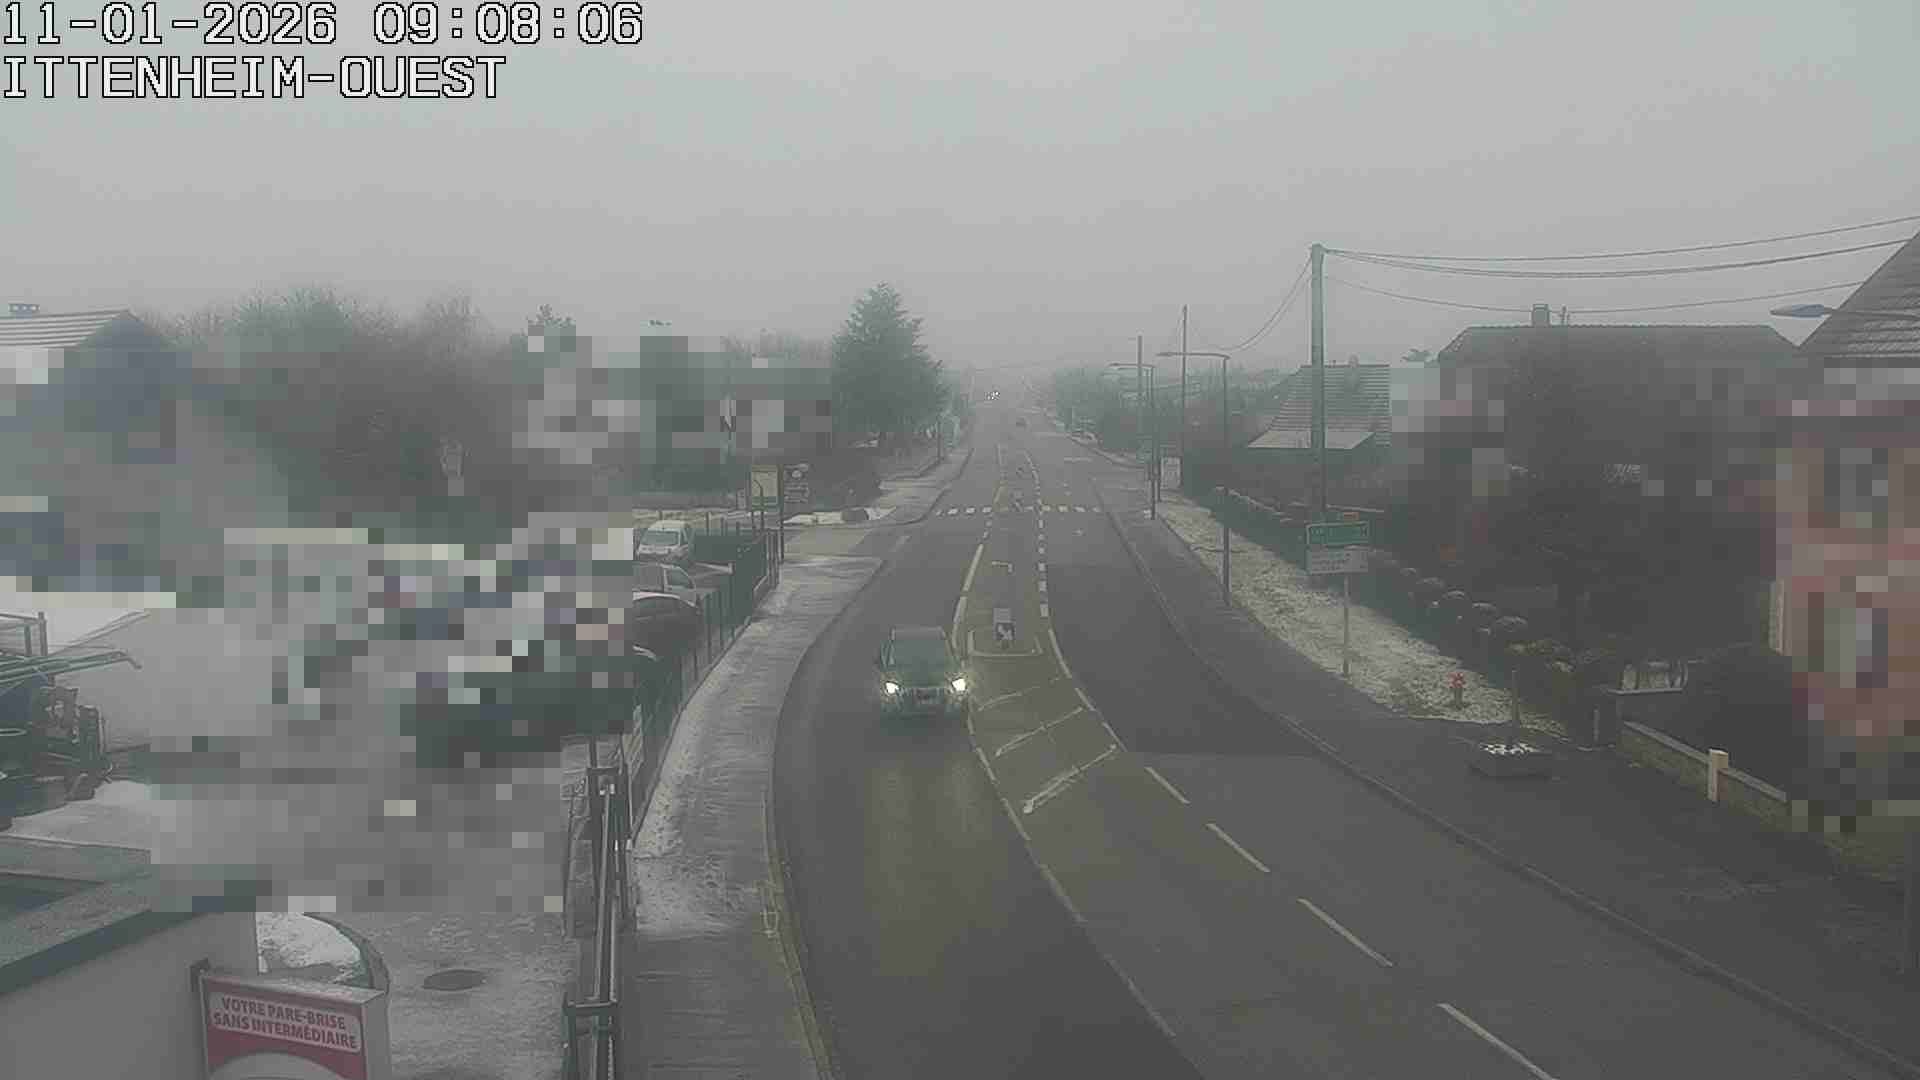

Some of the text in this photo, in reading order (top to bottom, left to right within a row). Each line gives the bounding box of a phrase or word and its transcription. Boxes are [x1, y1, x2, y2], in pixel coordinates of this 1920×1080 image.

[213, 1012, 358, 1049] SANS INTERMÉDIAIRE
[222, 997, 346, 1030] VOTRE PARE-BRISE
